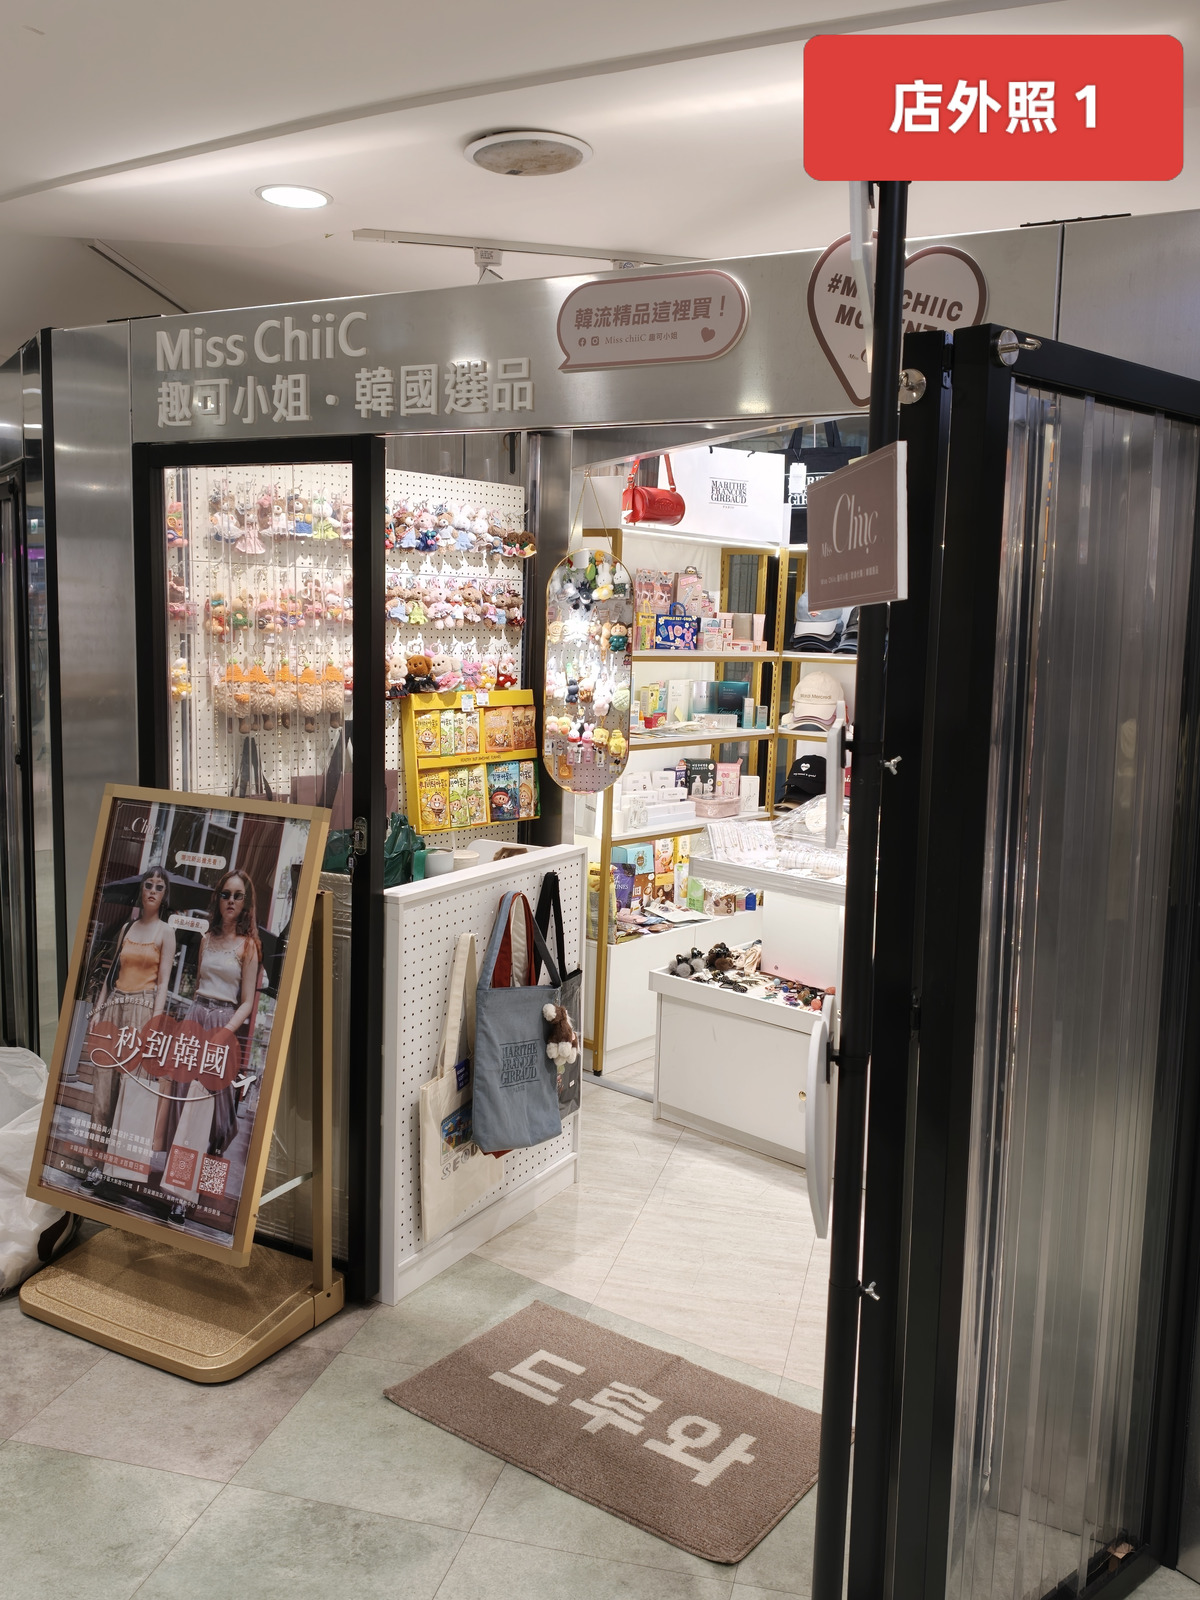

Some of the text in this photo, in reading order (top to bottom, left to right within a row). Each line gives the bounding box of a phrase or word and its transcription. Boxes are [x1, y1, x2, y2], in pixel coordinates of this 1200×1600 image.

[574, 295, 726, 330] 韓流精品這裡買！
[155, 310, 368, 372] Miss ChiiC
[605, 334, 623, 345] Miss
[711, 480, 747, 490] MARITHE
[711, 494, 747, 504] GIRBAUD
[88, 1024, 230, 1080] 一秒到韓國
[441, 1143, 478, 1181] SEOU
[488, 1349, 757, 1488] 드루와
